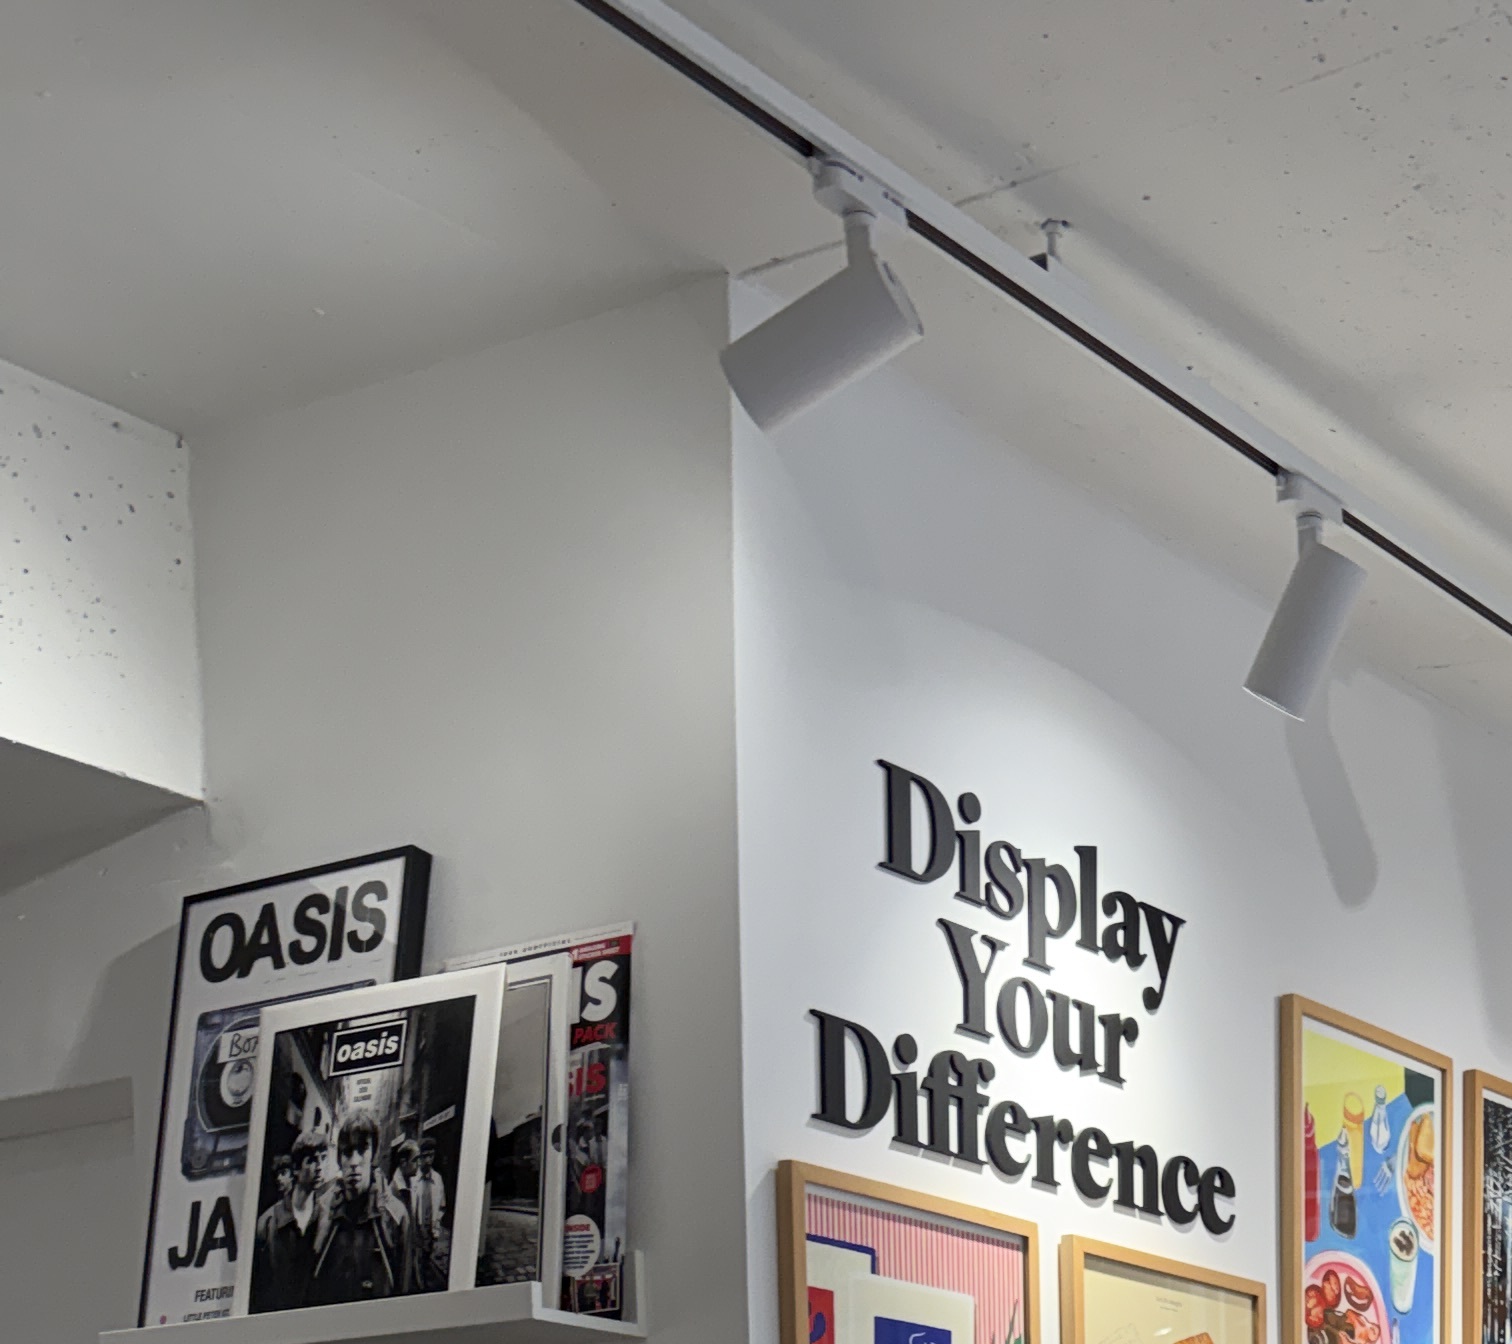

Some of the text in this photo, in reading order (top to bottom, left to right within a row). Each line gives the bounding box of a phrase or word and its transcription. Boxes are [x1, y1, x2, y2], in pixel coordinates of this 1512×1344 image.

[200, 880, 389, 984] OASIS
[875, 759, 1186, 1013] Display
[336, 1031, 400, 1063] oasis
[937, 918, 1139, 1085] Your
[809, 1008, 1237, 1235] Difference
